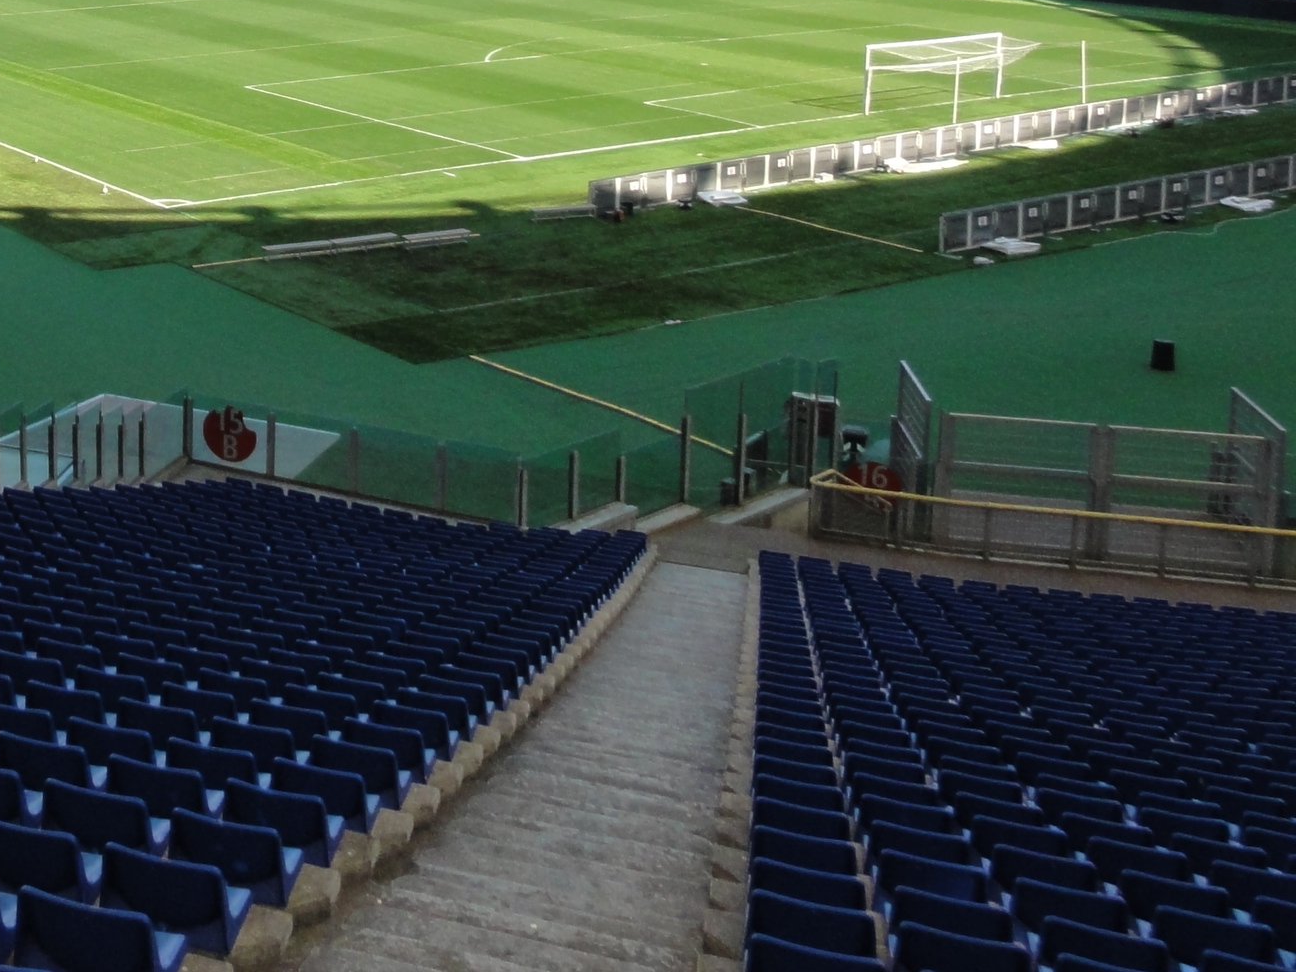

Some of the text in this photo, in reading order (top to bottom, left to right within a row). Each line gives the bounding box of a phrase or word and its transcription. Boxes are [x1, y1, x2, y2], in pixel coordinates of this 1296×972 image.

[219, 407, 244, 435] 15
[223, 434, 238, 459] B
[857, 463, 888, 488] 16
